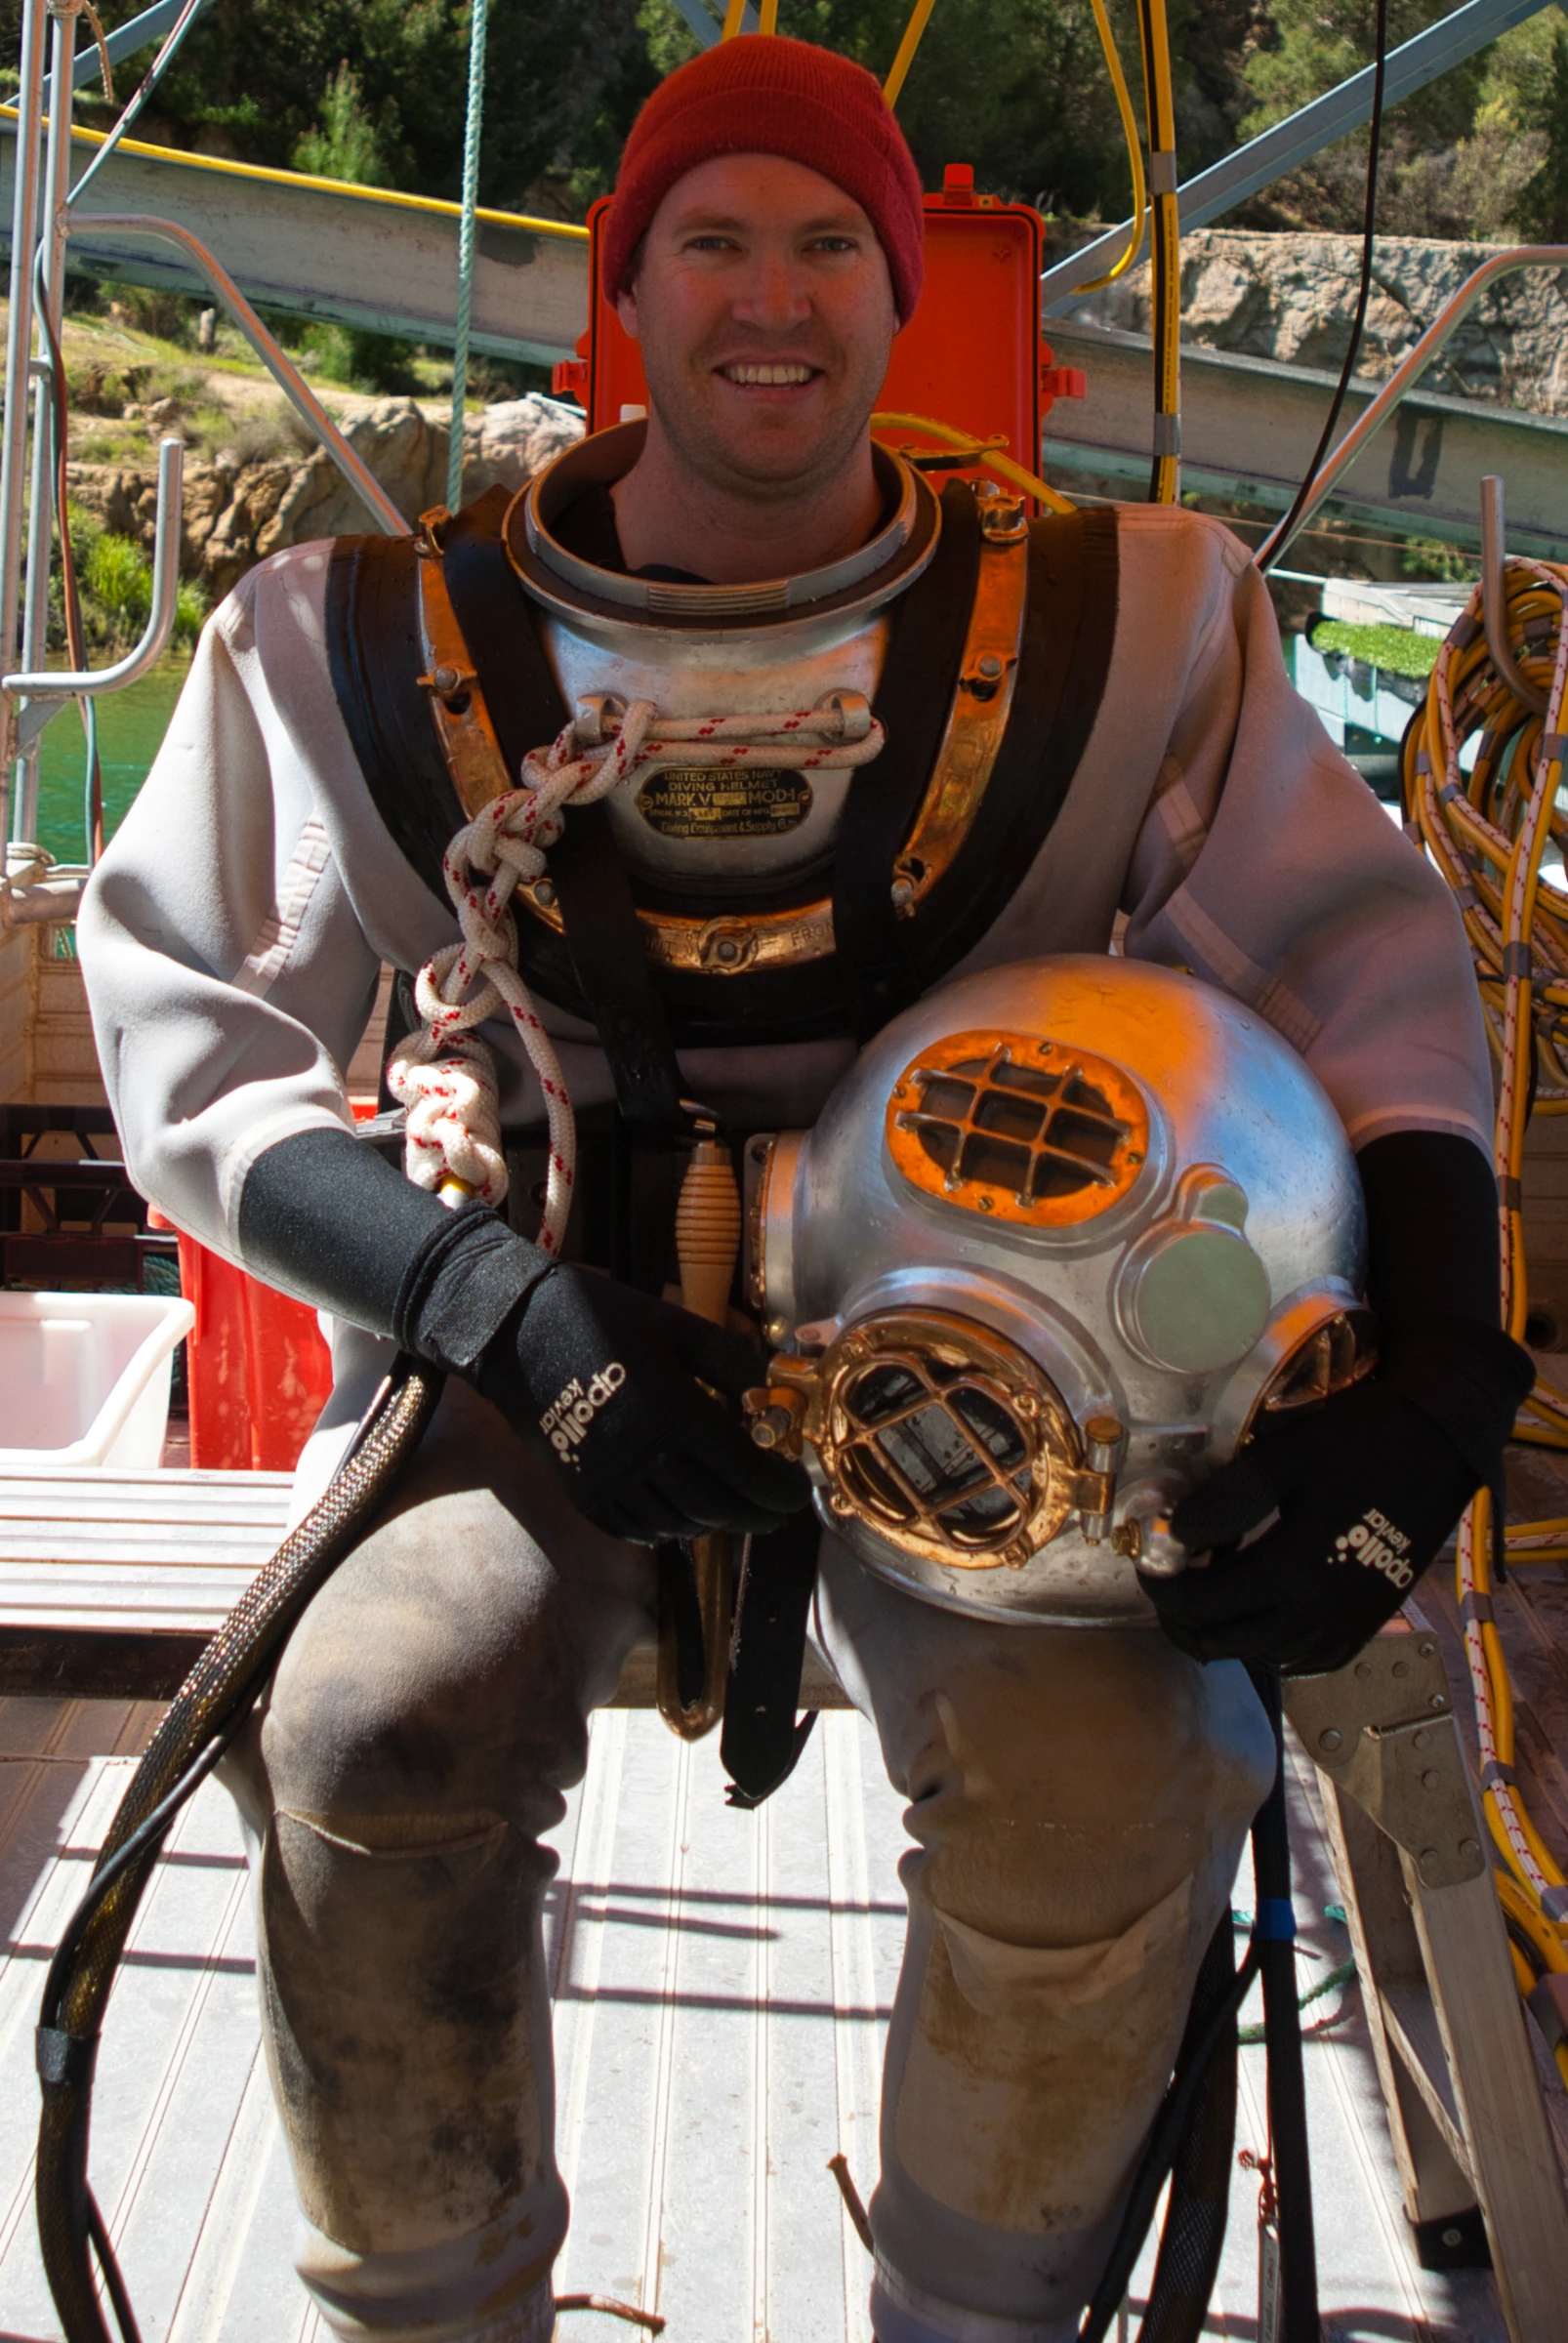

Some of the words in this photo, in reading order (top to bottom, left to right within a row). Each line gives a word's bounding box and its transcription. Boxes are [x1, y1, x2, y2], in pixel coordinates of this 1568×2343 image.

[665, 771, 706, 782] UNITED
[709, 769, 749, 781] STATES
[752, 768, 783, 779] NAVY
[669, 782, 716, 792] DIVING
[721, 779, 779, 791] HELMET
[698, 792, 712, 806] V
[747, 819, 777, 834] Supply
[551, 1361, 627, 1451] apollo
[1347, 1524, 1415, 1589] apollo
